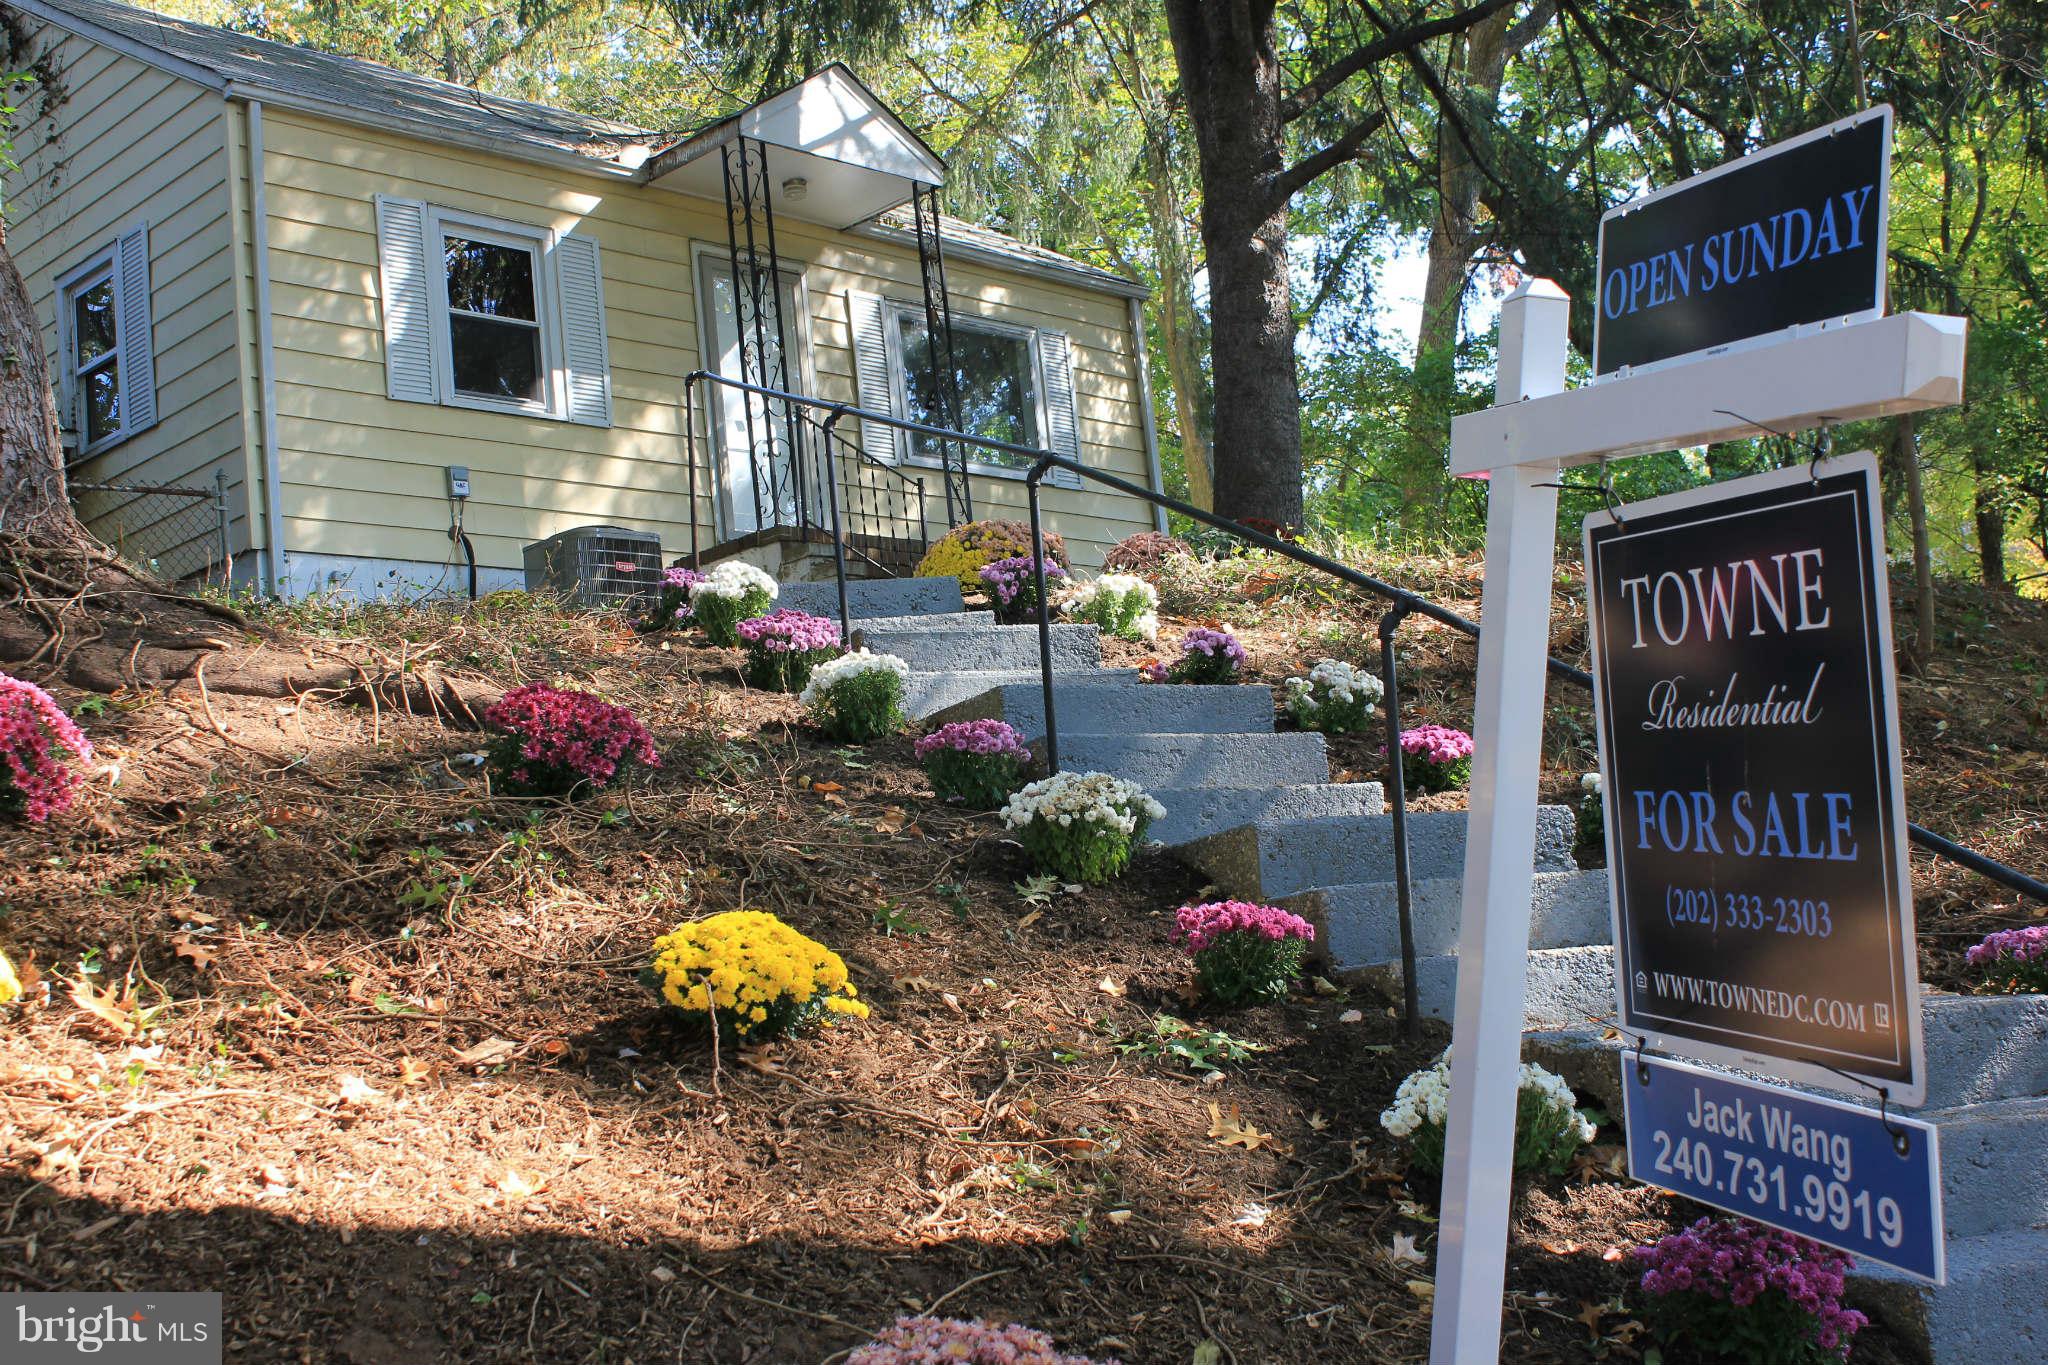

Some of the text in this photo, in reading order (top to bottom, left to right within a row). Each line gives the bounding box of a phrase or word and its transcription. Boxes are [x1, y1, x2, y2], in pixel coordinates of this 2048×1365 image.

[1604, 186, 1873, 319] OPEN SUNDAY
[1621, 549, 1831, 648] TOWNE
[1642, 662, 1825, 730] Residential
[1634, 791, 1857, 861] FOR SALE
[1667, 884, 1832, 938] (202) 333-2303
[1653, 971, 1866, 1032] WWW.TOWNEDC.COM
[1687, 1088, 1850, 1182] Jack Wang
[1653, 1130, 1902, 1247] 240.731.9919
